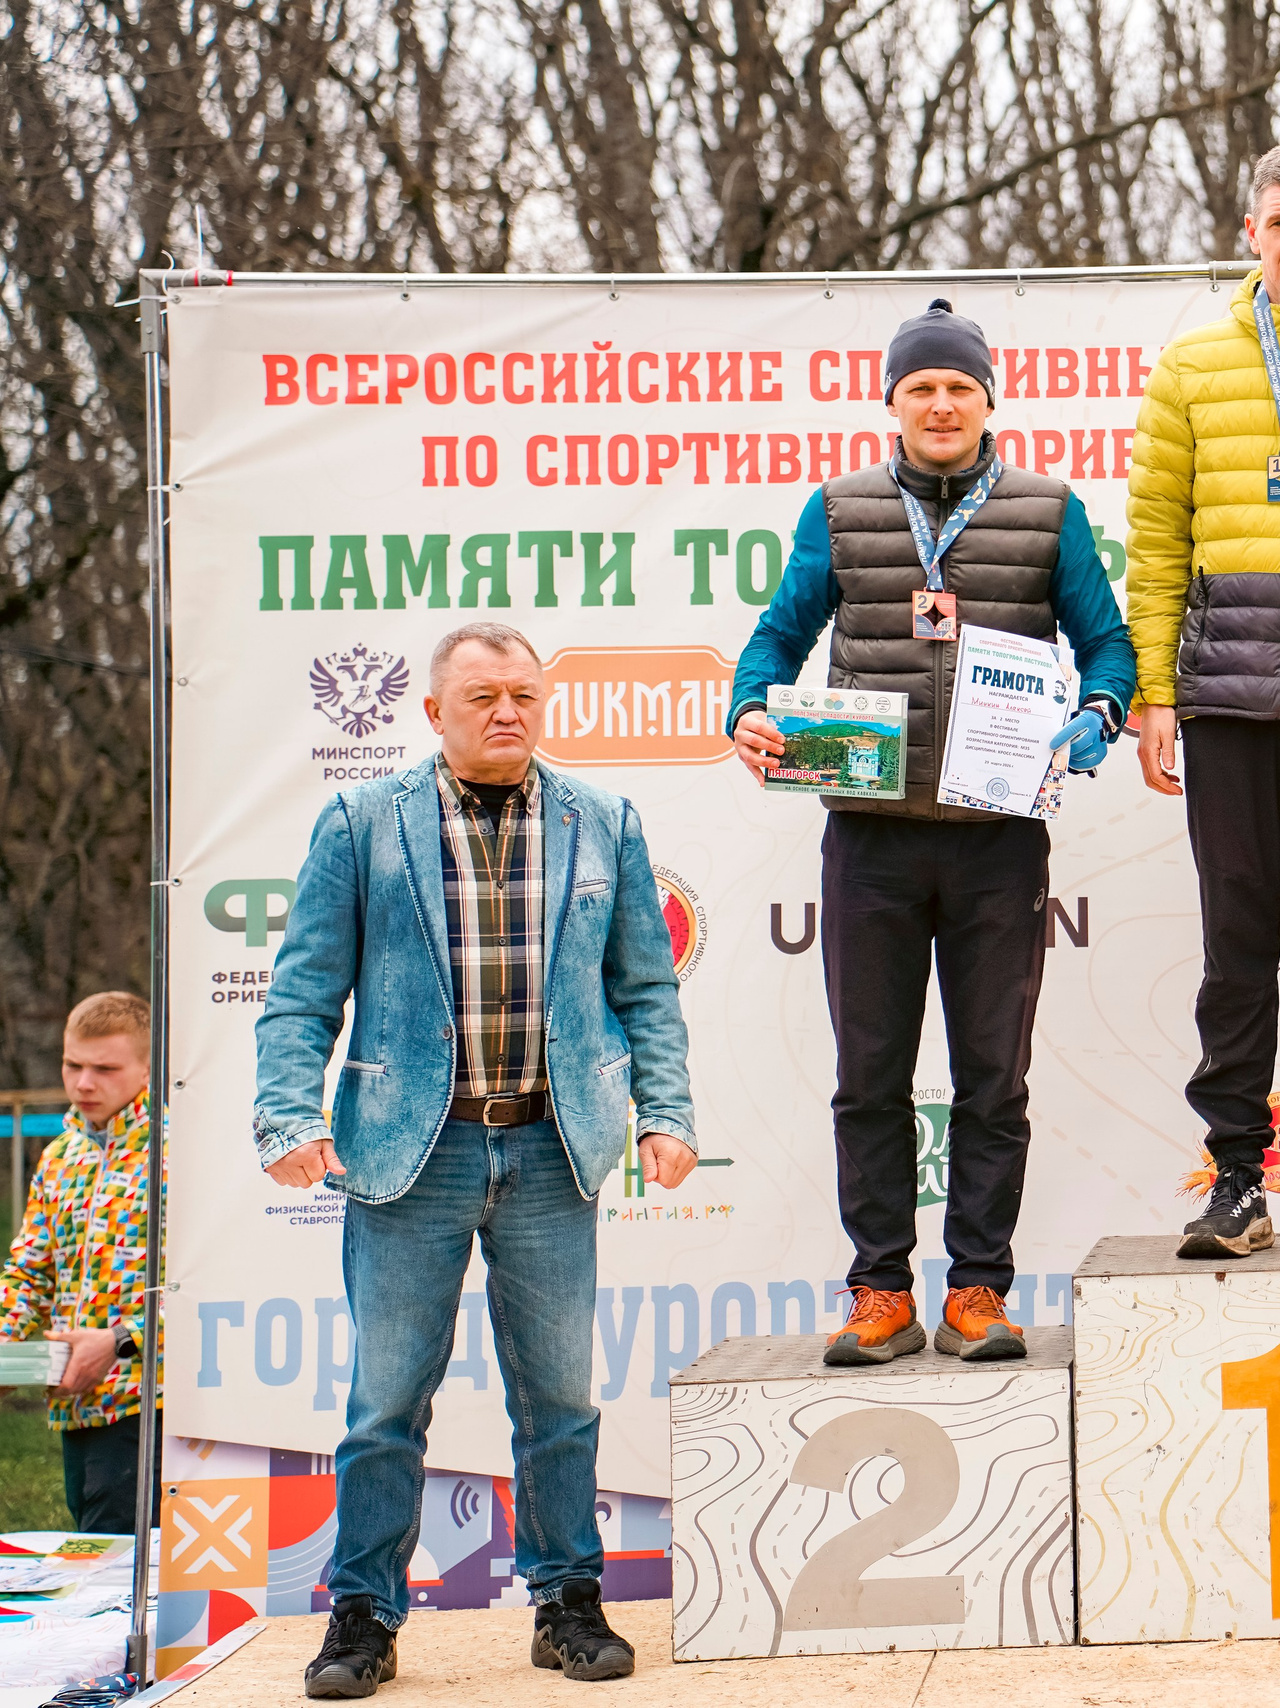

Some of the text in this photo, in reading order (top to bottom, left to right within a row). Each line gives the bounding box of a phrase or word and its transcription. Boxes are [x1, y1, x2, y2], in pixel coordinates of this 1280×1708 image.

[1255, 308, 1275, 364] СОРЕВНОВАНИЯ
[261, 340, 783, 406] ВСЕРОССИЙСКИЕ
[421, 435, 498, 488] ПО
[526, 432, 887, 487] СПОРТИВНО
[905, 494, 920, 533] ВОЕННОГО
[914, 532, 928, 563] ПАМЯТИ
[258, 532, 635, 611] ПАМЯТИ
[918, 594, 928, 609] 2
[967, 646, 1053, 669] ПАМЯТИ ТОПОГРАФА ПАСТУХОВА
[971, 665, 1045, 696] ГРАМОТА
[988, 691, 1029, 702] НАГРАЖДАЕТСЯ
[792, 710, 821, 718] ПОЛЕЗНЫЕ
[823, 712, 850, 720] СЛАДОСТИ
[993, 724, 1019, 732] ФЕСТИВАЛЕ
[966, 737, 994, 745] ВОЗРАСТНАЯ
[967, 728, 1040, 744] СПОРТИВНОГО ОРИЕНТИРОВАНИЯ
[312, 745, 406, 762] МИНСПОРТ
[997, 749, 1035, 760] КРОСС-КЛАССИКА
[324, 767, 394, 780] РОССИИ
[767, 768, 821, 781] ПЯТИГОРСК
[811, 787, 846, 795] МИНЕРАЛЬНЫХ
[652, 864, 708, 982] ЕДЕРАЦИЯ СПОРТИВНОГО
[212, 971, 274, 985] ФЕДЕ
[212, 990, 267, 1003] ОРИЕ
[314, 1193, 346, 1202] МИНИ
[265, 1203, 339, 1215] ФИЗИЧЕСКОЙ
[290, 1216, 345, 1225] СТАВРОПО
[784, 1407, 966, 1631] 2
